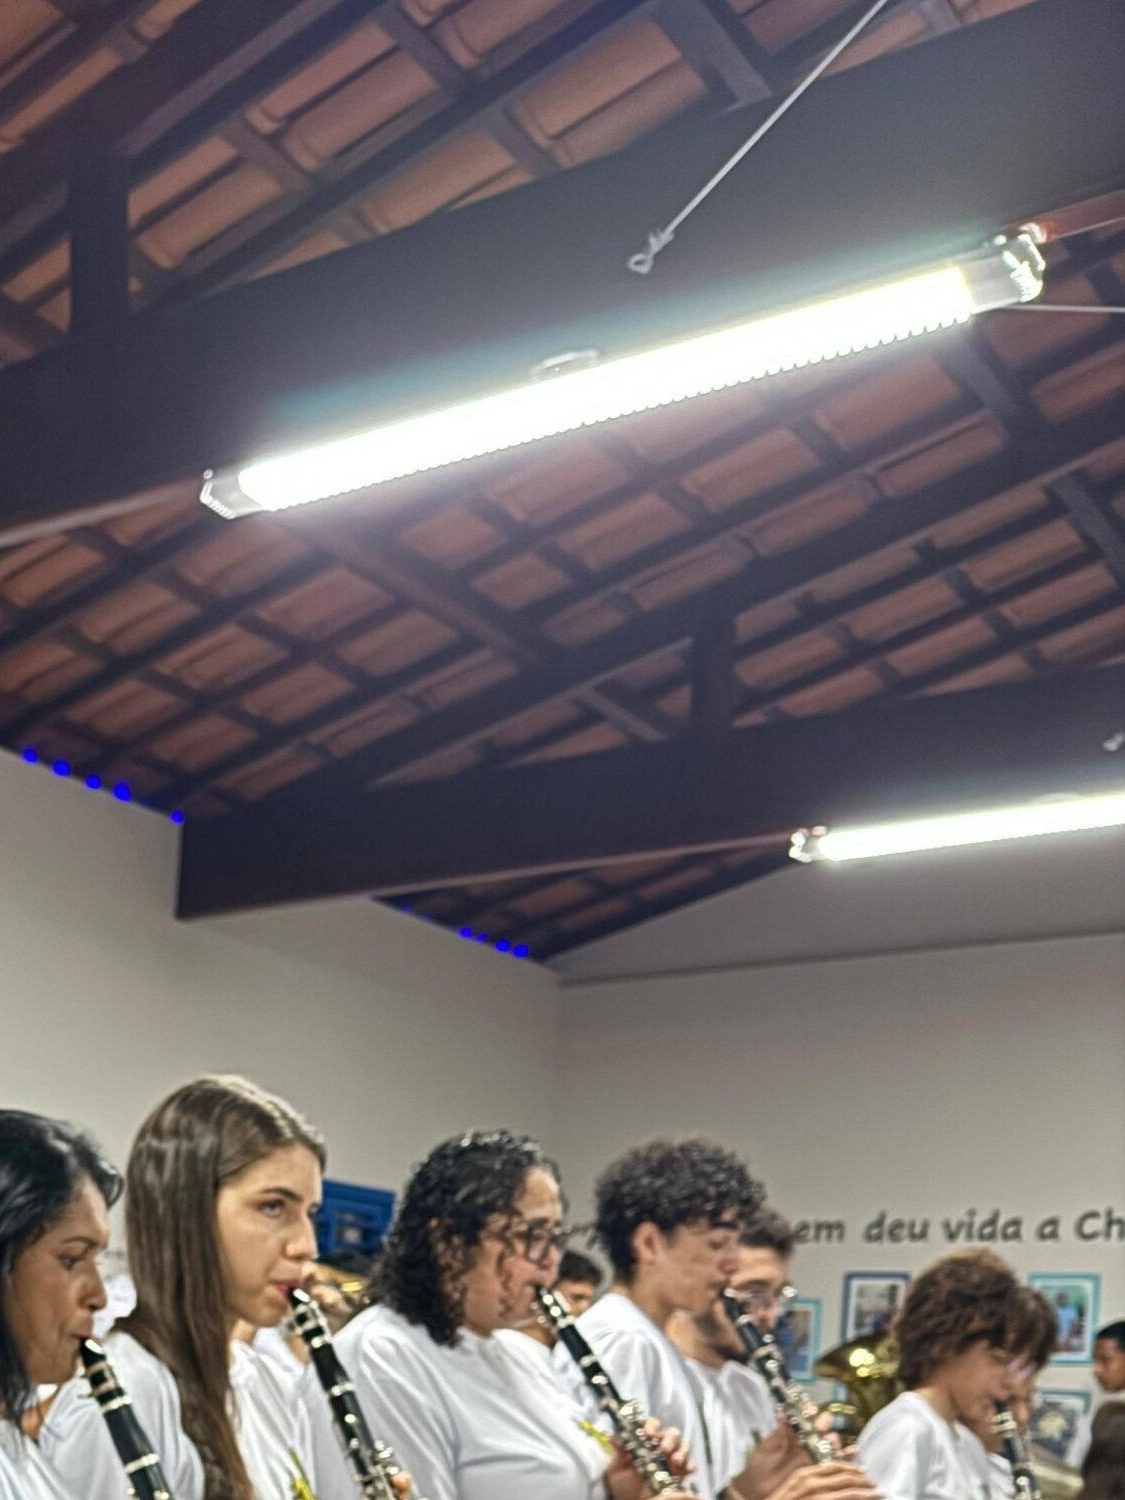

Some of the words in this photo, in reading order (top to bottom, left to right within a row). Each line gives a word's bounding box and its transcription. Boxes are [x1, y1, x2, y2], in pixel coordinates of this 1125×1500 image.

[863, 1210, 929, 1244] deu
[942, 1208, 1023, 1244] vida
[1036, 1216, 1061, 1243] a
[1075, 1207, 1125, 1243] Ch
